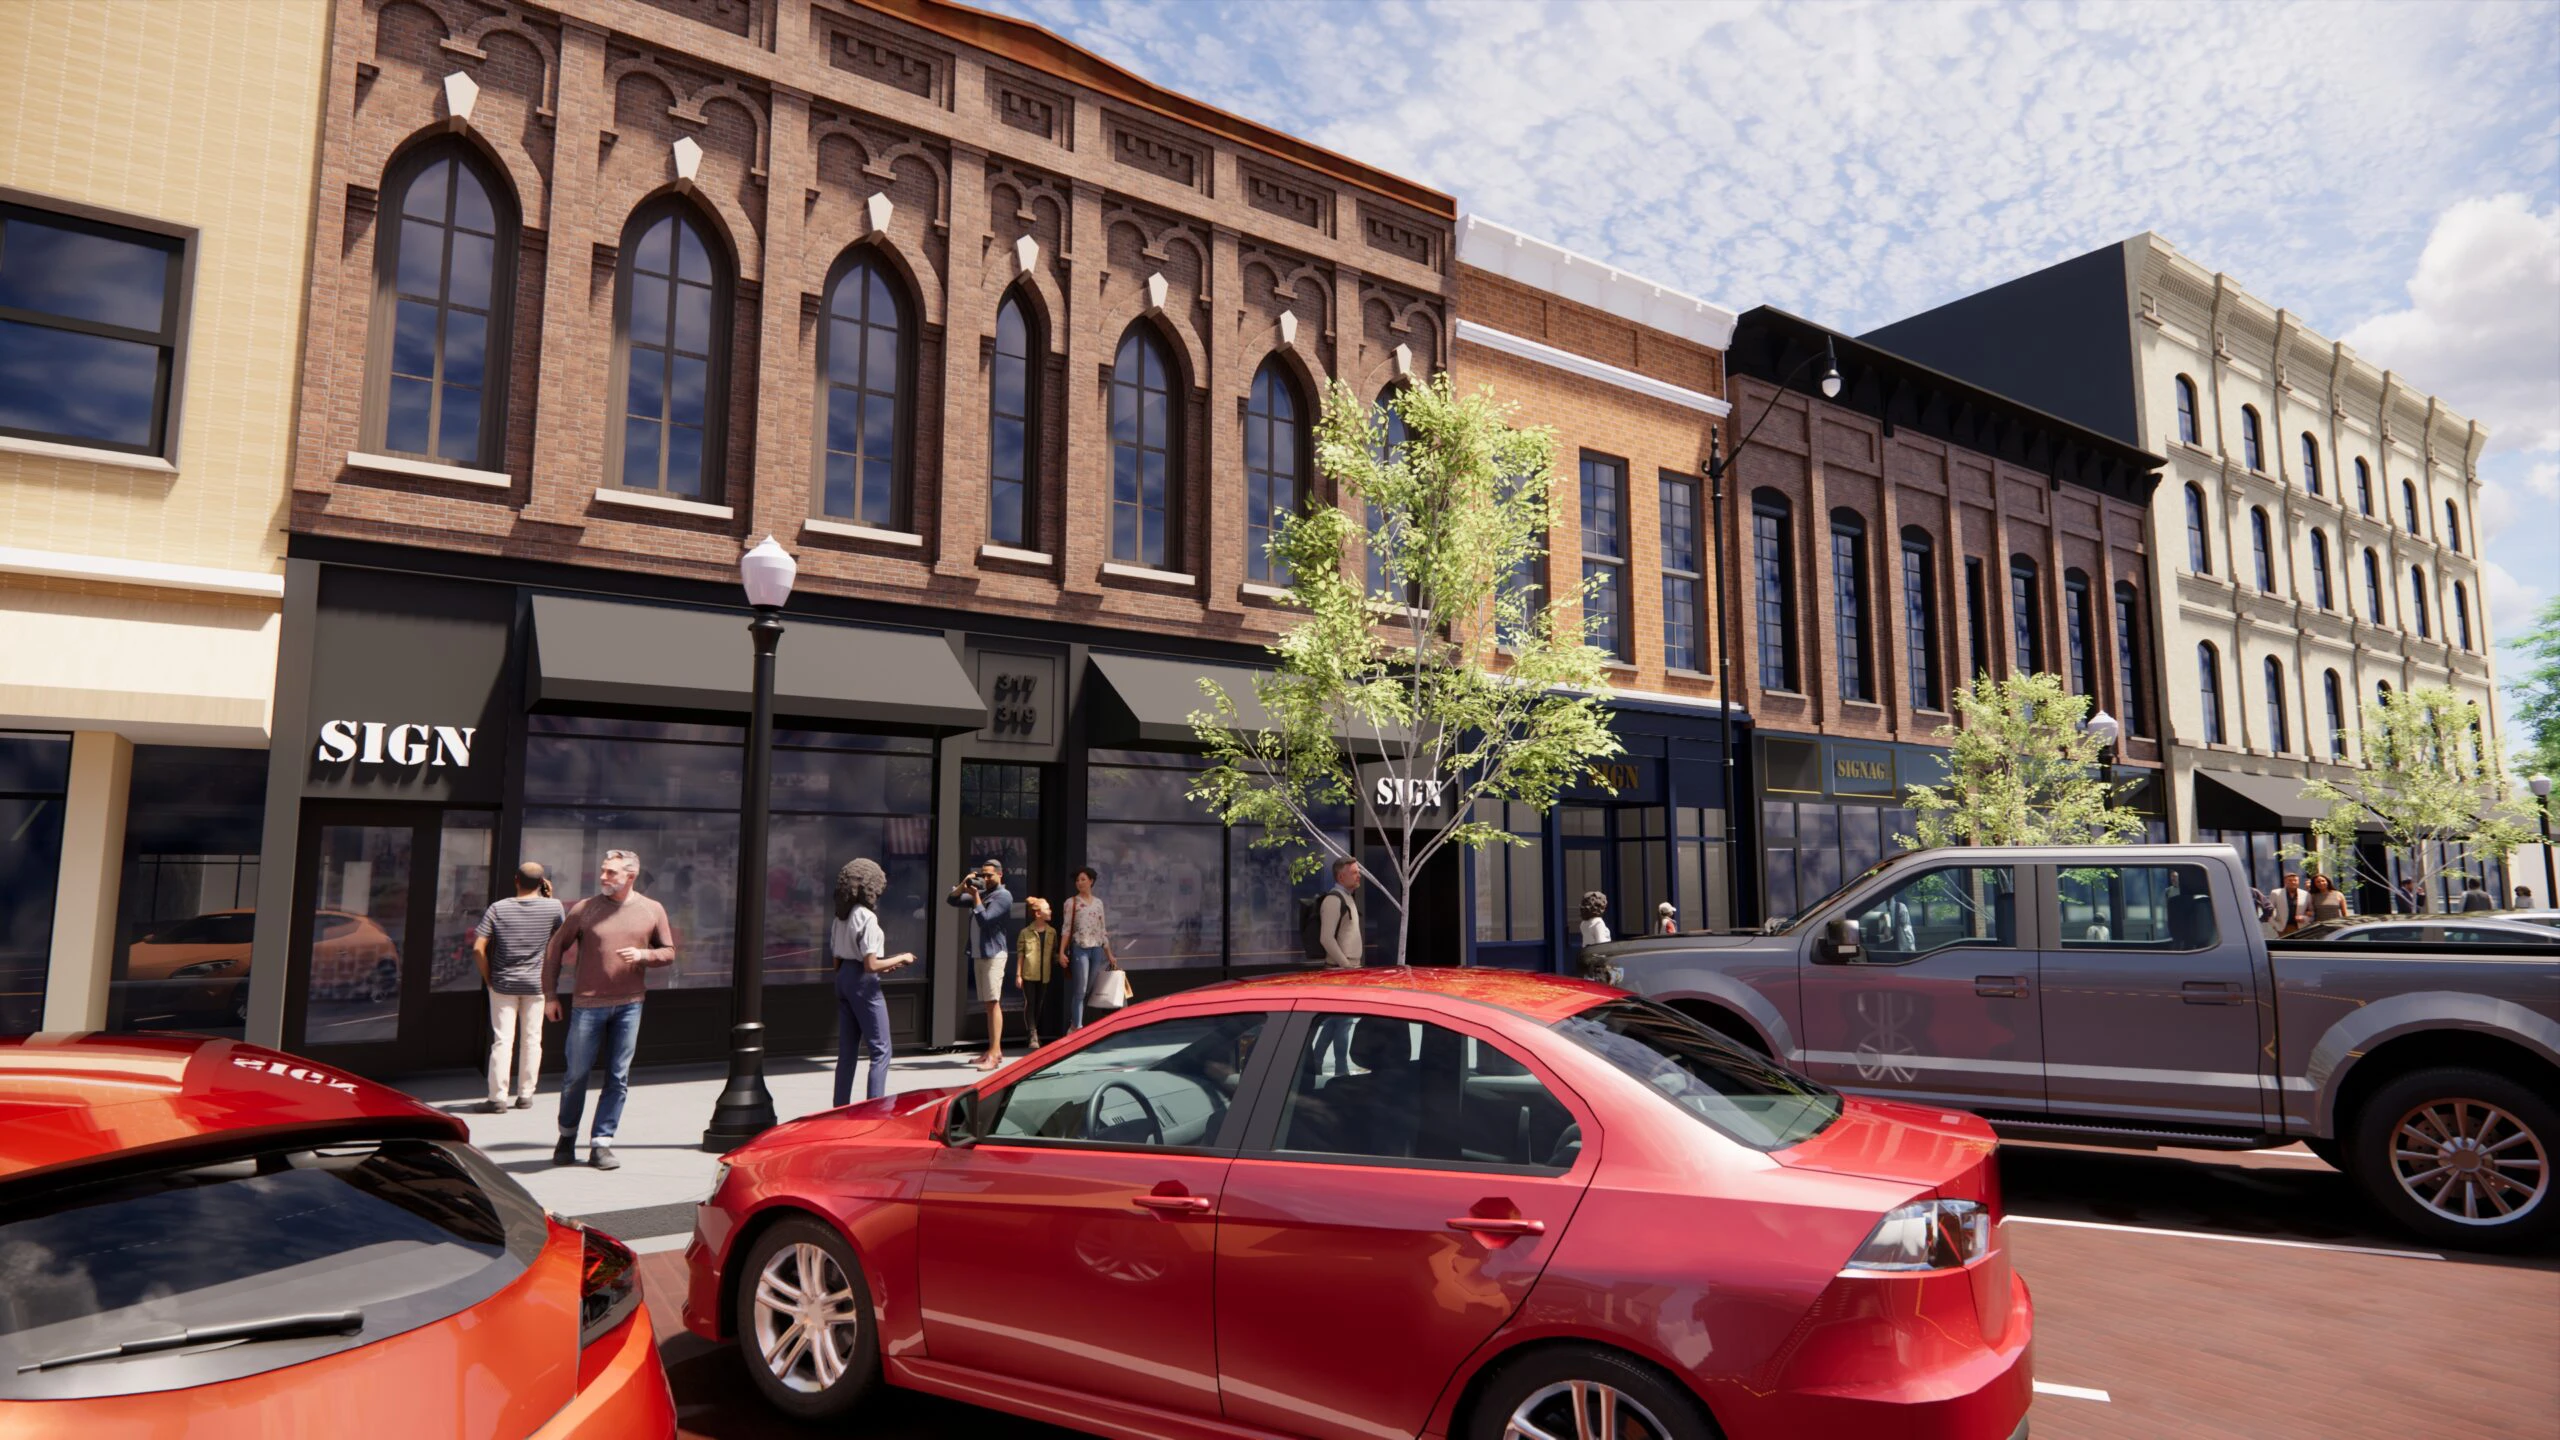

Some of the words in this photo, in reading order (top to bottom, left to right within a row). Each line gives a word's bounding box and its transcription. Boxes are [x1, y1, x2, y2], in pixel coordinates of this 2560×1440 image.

[996, 672, 1038, 692] 317
[995, 705, 1037, 723] 319
[318, 720, 477, 768] SIGN
[1837, 759, 1893, 779] SIGNAG
[1377, 777, 1443, 807] SIGN
